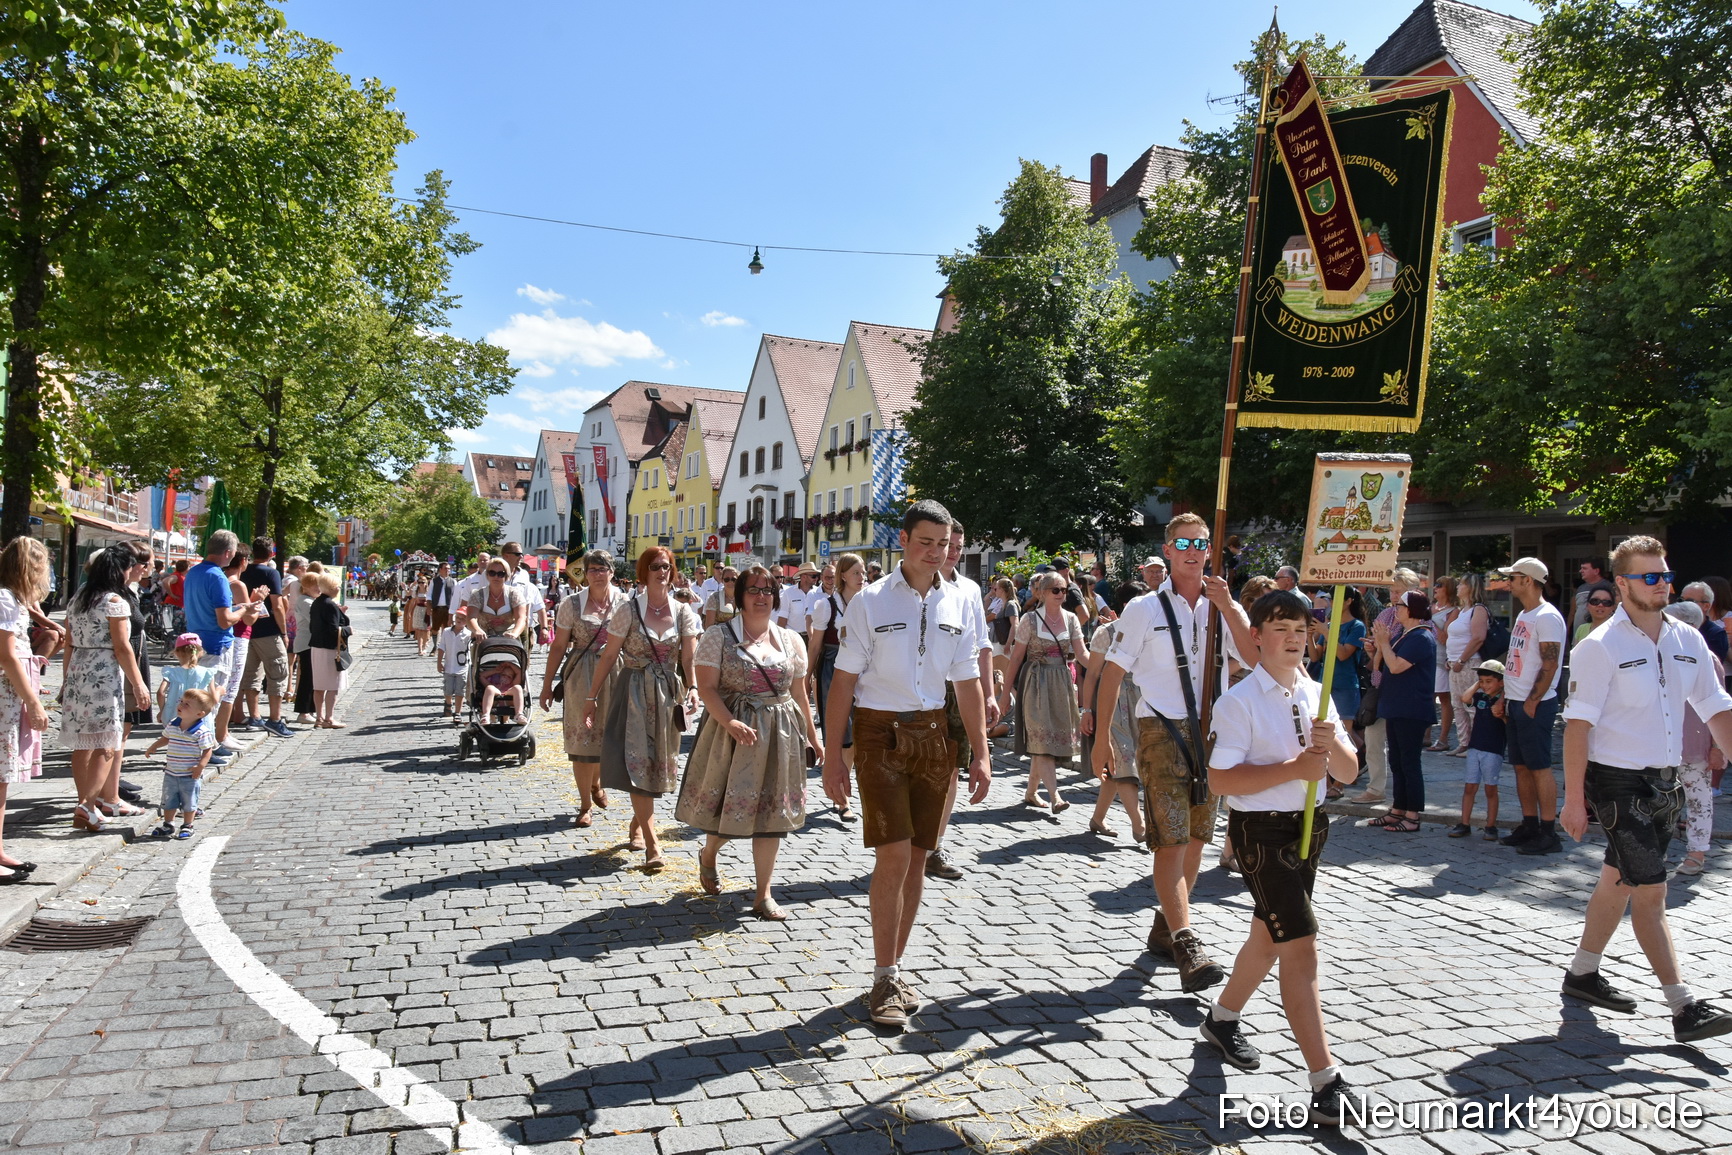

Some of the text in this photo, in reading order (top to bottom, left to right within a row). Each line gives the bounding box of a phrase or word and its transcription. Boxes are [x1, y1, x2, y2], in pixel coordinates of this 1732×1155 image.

[1277, 303, 1396, 344] WEIDENWANG
[1301, 366, 1323, 378] 1978
[1330, 366, 1355, 378] 2009
[1315, 568, 1384, 581] Weidenwang
